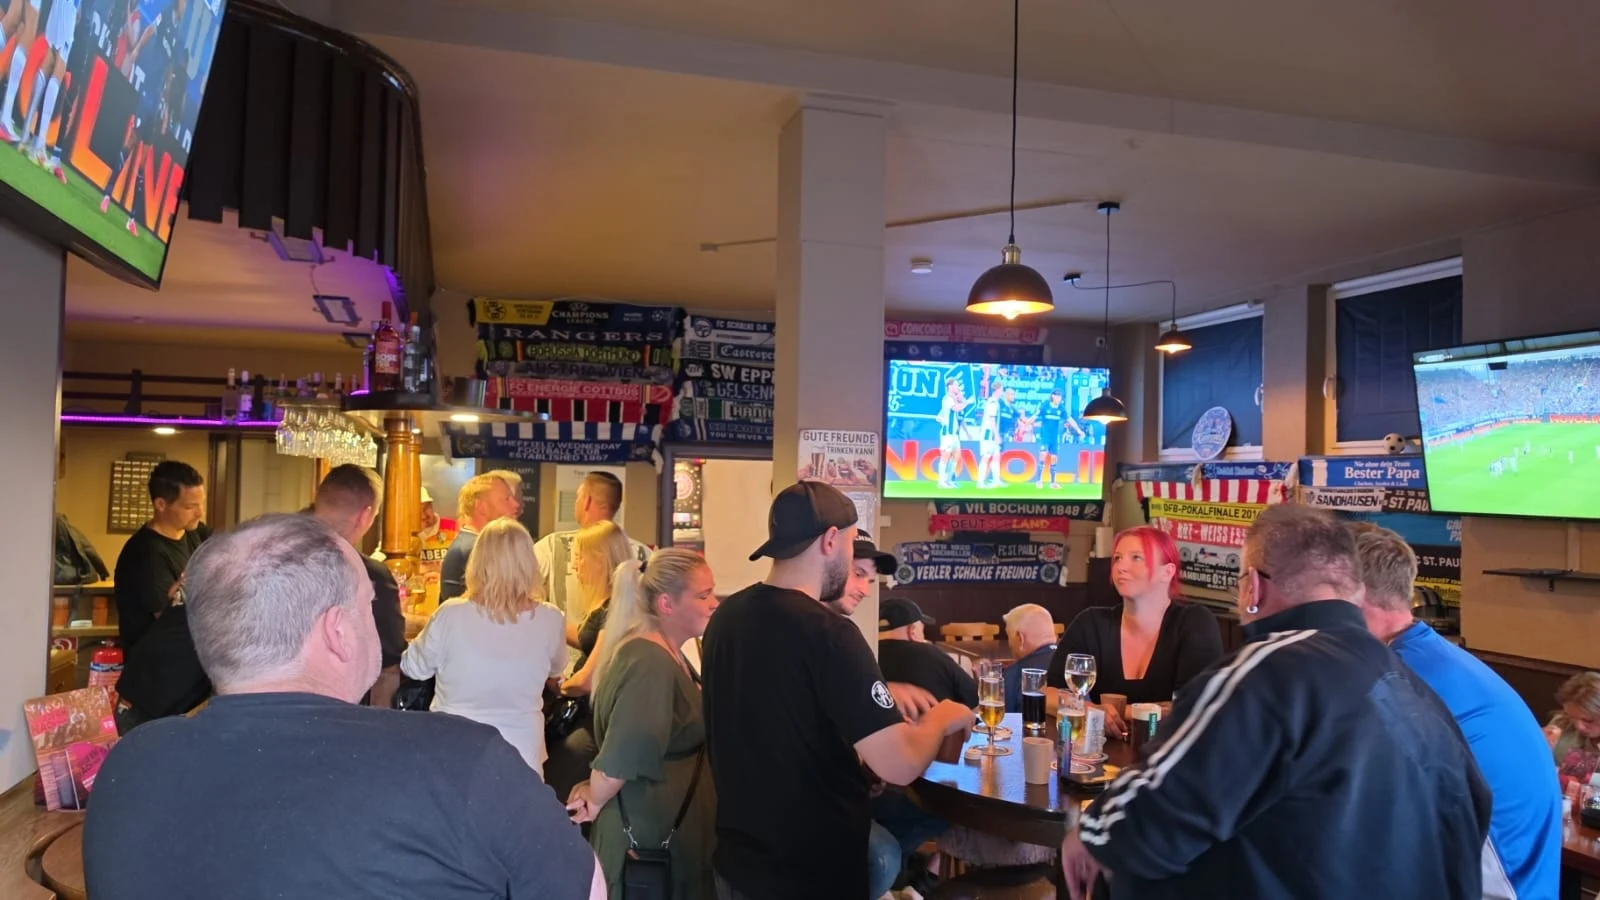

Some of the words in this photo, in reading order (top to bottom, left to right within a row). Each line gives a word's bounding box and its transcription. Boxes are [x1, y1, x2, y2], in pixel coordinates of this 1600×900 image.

[551, 310, 609, 320] CHAMPIONS
[503, 327, 663, 341] RANGERS
[711, 363, 737, 380] SW
[741, 367, 775, 385] EPP
[509, 383, 524, 392] FC
[527, 384, 580, 395] ENERGIE
[583, 386, 639, 397] COTTBUS
[803, 431, 829, 442] GUTE
[831, 433, 875, 444] FREUNDE
[496, 440, 556, 449] SHEFFIELD
[557, 442, 622, 450] WEDNESDAY
[508, 452, 581, 462] ESTABLISHED
[517, 447, 571, 456] FOOTBALL
[573, 448, 600, 456] CLUB
[827, 446, 854, 454] TRINKEN
[855, 447, 875, 457] KANN!
[886, 440, 1105, 483] NOVOLI
[1344, 466, 1384, 479] Bester
[1387, 467, 1420, 482] Papa
[1316, 494, 1379, 507] SANDHAUSEN
[988, 504, 1048, 515] BOCHUM
[1051, 505, 1080, 516] 1848
[1163, 503, 1240, 519] DFB-POKALFINALE
[419, 549, 448, 560] ABER
[998, 545, 1008, 556] FC
[1018, 544, 1038, 556] PAULI
[1423, 556, 1438, 566] ST.
[1439, 557, 1461, 568] PAU
[916, 566, 950, 580] VERLER
[952, 566, 993, 580] SCHALKE
[996, 566, 1038, 580] FREUNDE
